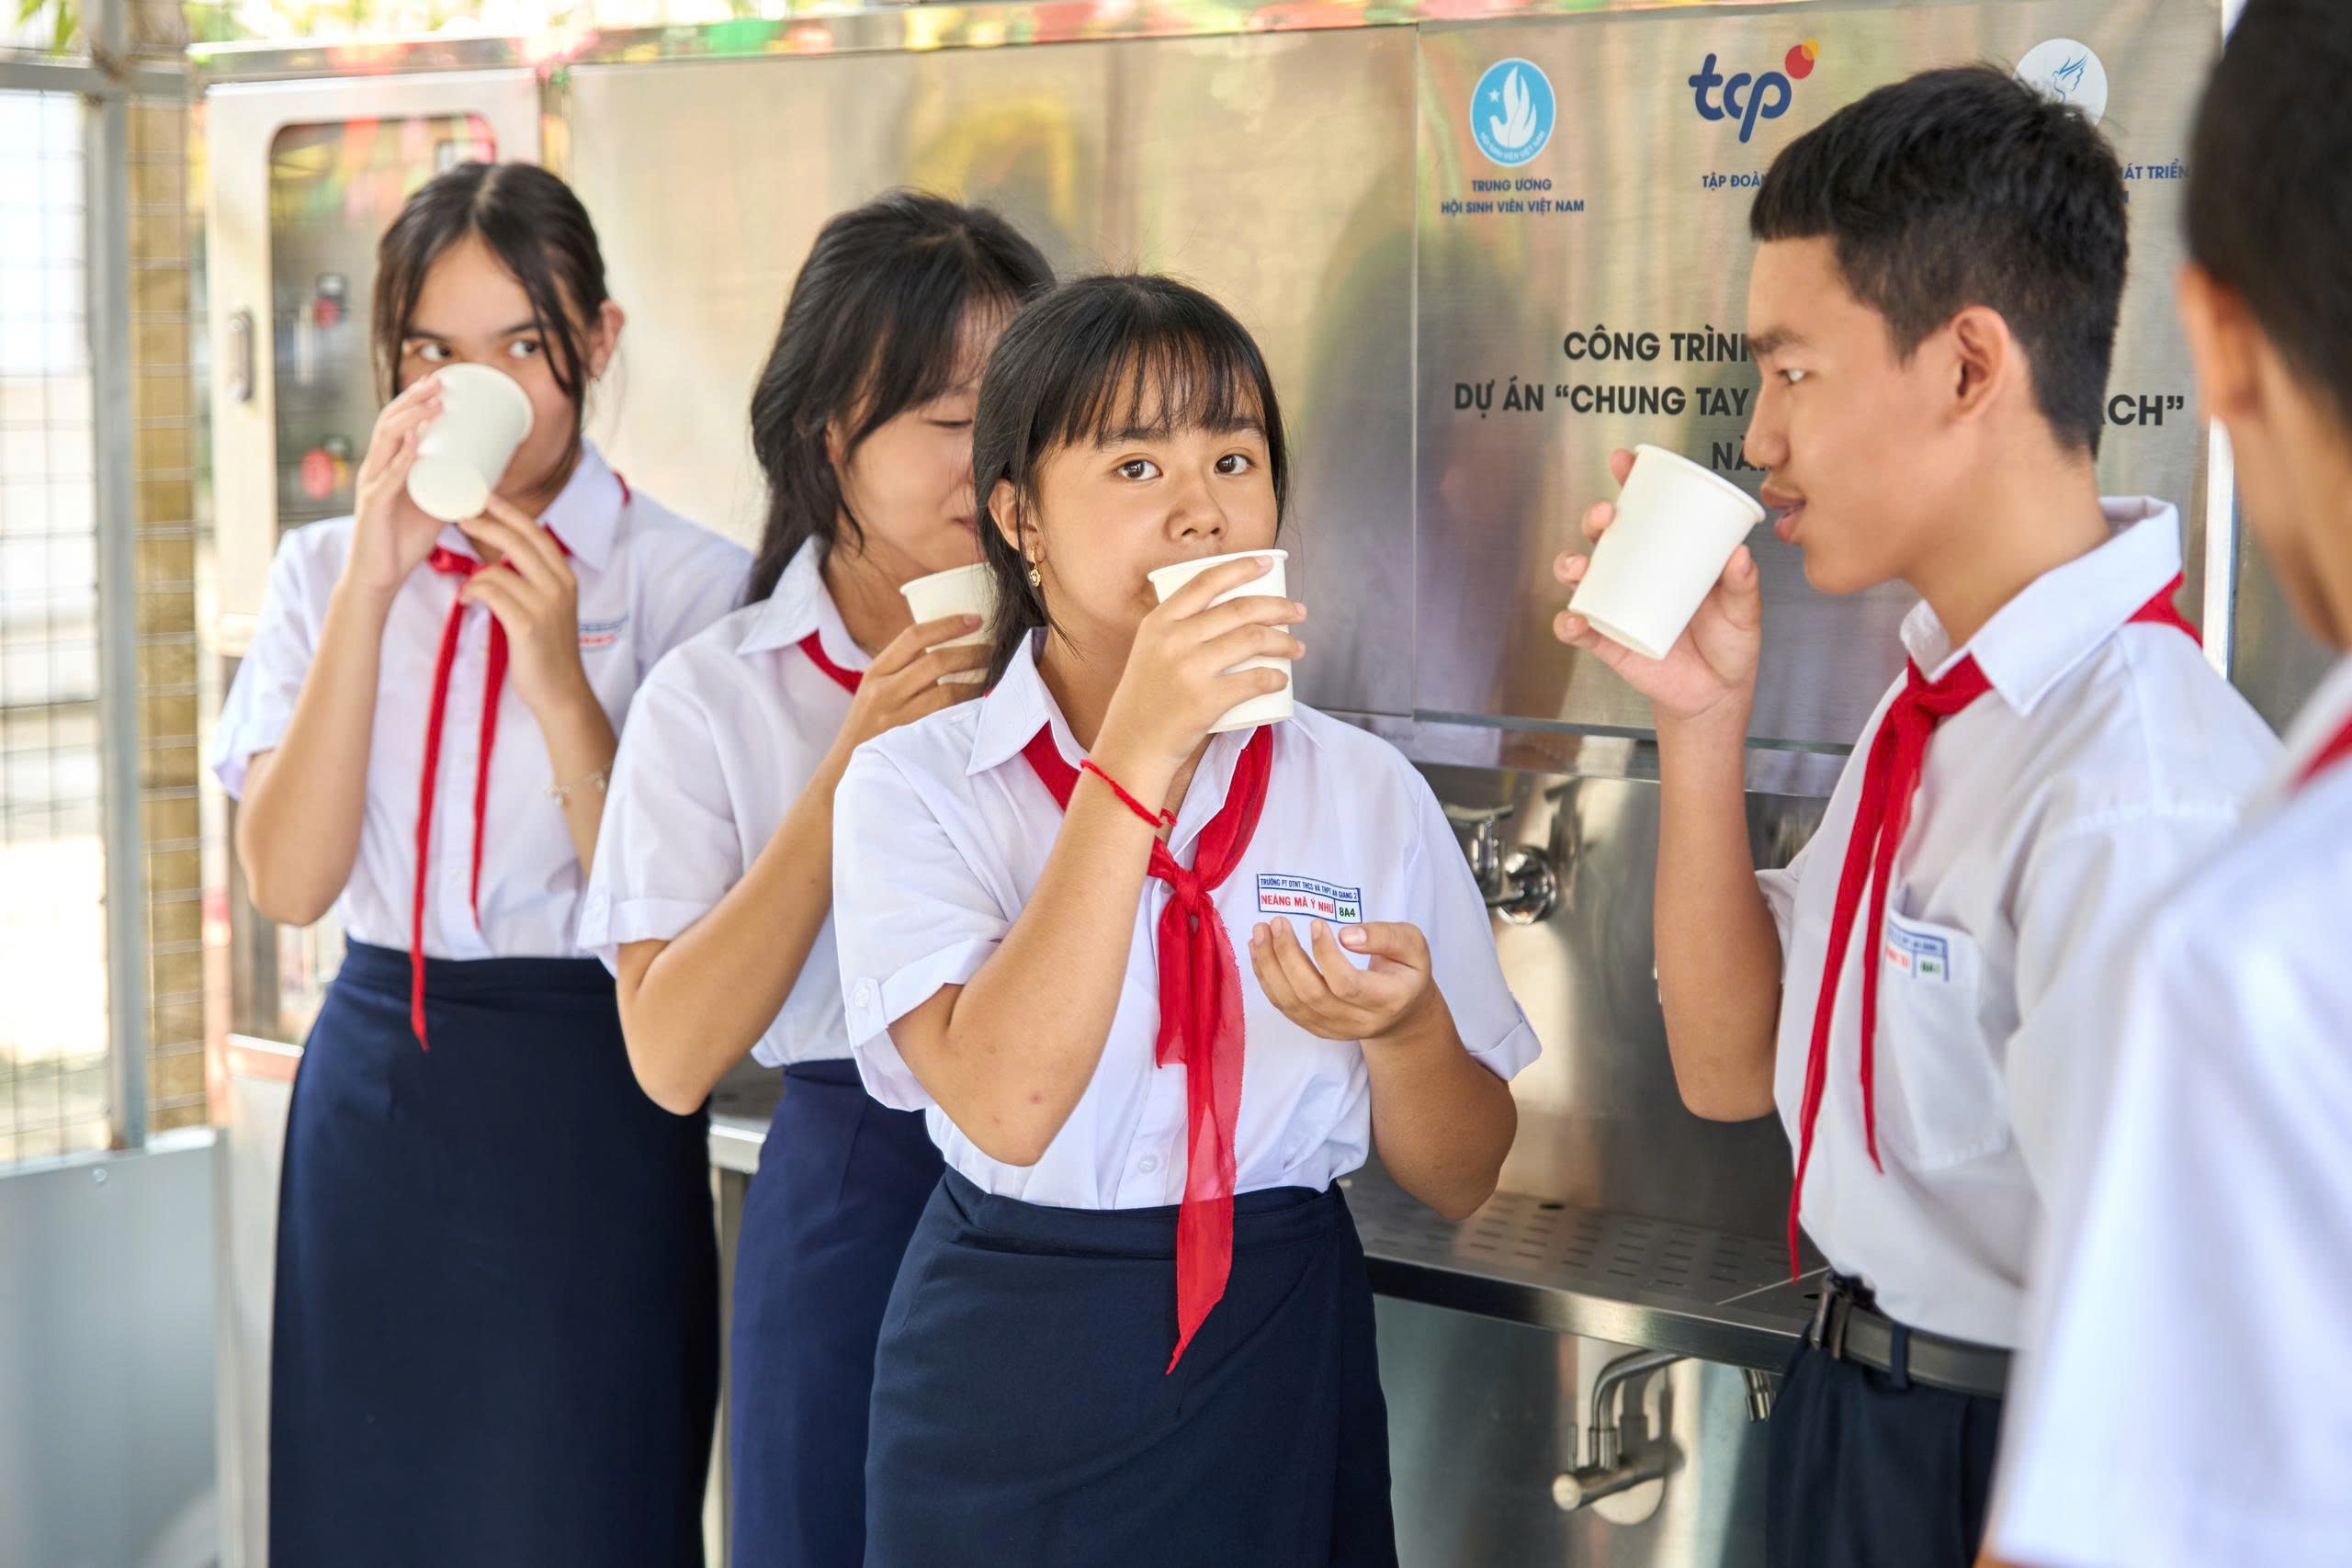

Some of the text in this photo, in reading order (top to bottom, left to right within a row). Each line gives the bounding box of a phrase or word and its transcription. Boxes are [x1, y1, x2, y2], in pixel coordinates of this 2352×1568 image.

[1688, 52, 1792, 143] tcp
[1472, 177, 1553, 192] TRUNG ƯƠNG
[1702, 171, 1726, 191] TẬP
[1441, 197, 1585, 216] HỘI SINH VIÊN VIỆT NAM
[1563, 323, 1661, 362] CÔNG
[1454, 375, 2184, 426] DỰ ÁN “CHUNG TAY CH”
[1339, 890, 1353, 899] GIANG
[1339, 907, 1356, 918] 8A4
